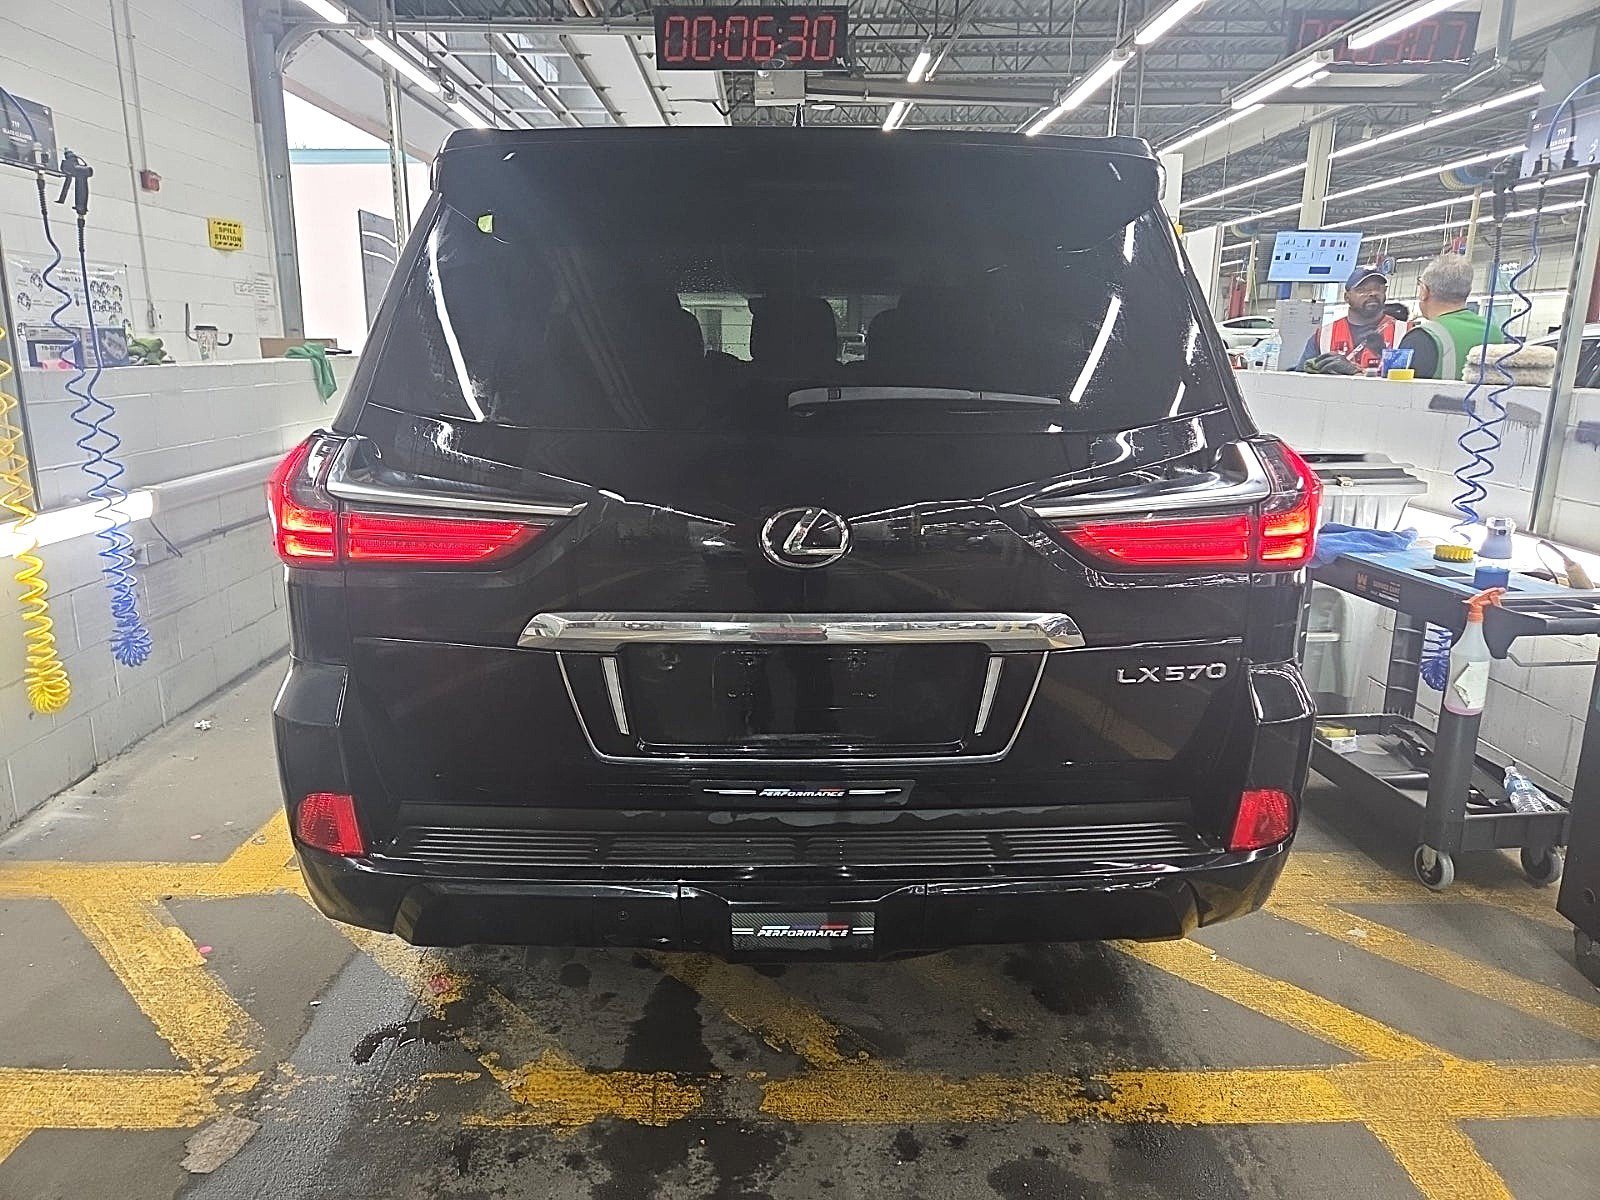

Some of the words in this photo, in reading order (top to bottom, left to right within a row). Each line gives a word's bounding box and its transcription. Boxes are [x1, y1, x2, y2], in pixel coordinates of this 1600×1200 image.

[663, 15, 837, 62] 00:06:30
[218, 226, 237, 235] SPILL
[214, 233, 242, 243] STATION
[1116, 666, 1160, 683] LX
[1165, 662, 1227, 681] 570
[757, 929, 849, 937] PERFORMANCE
